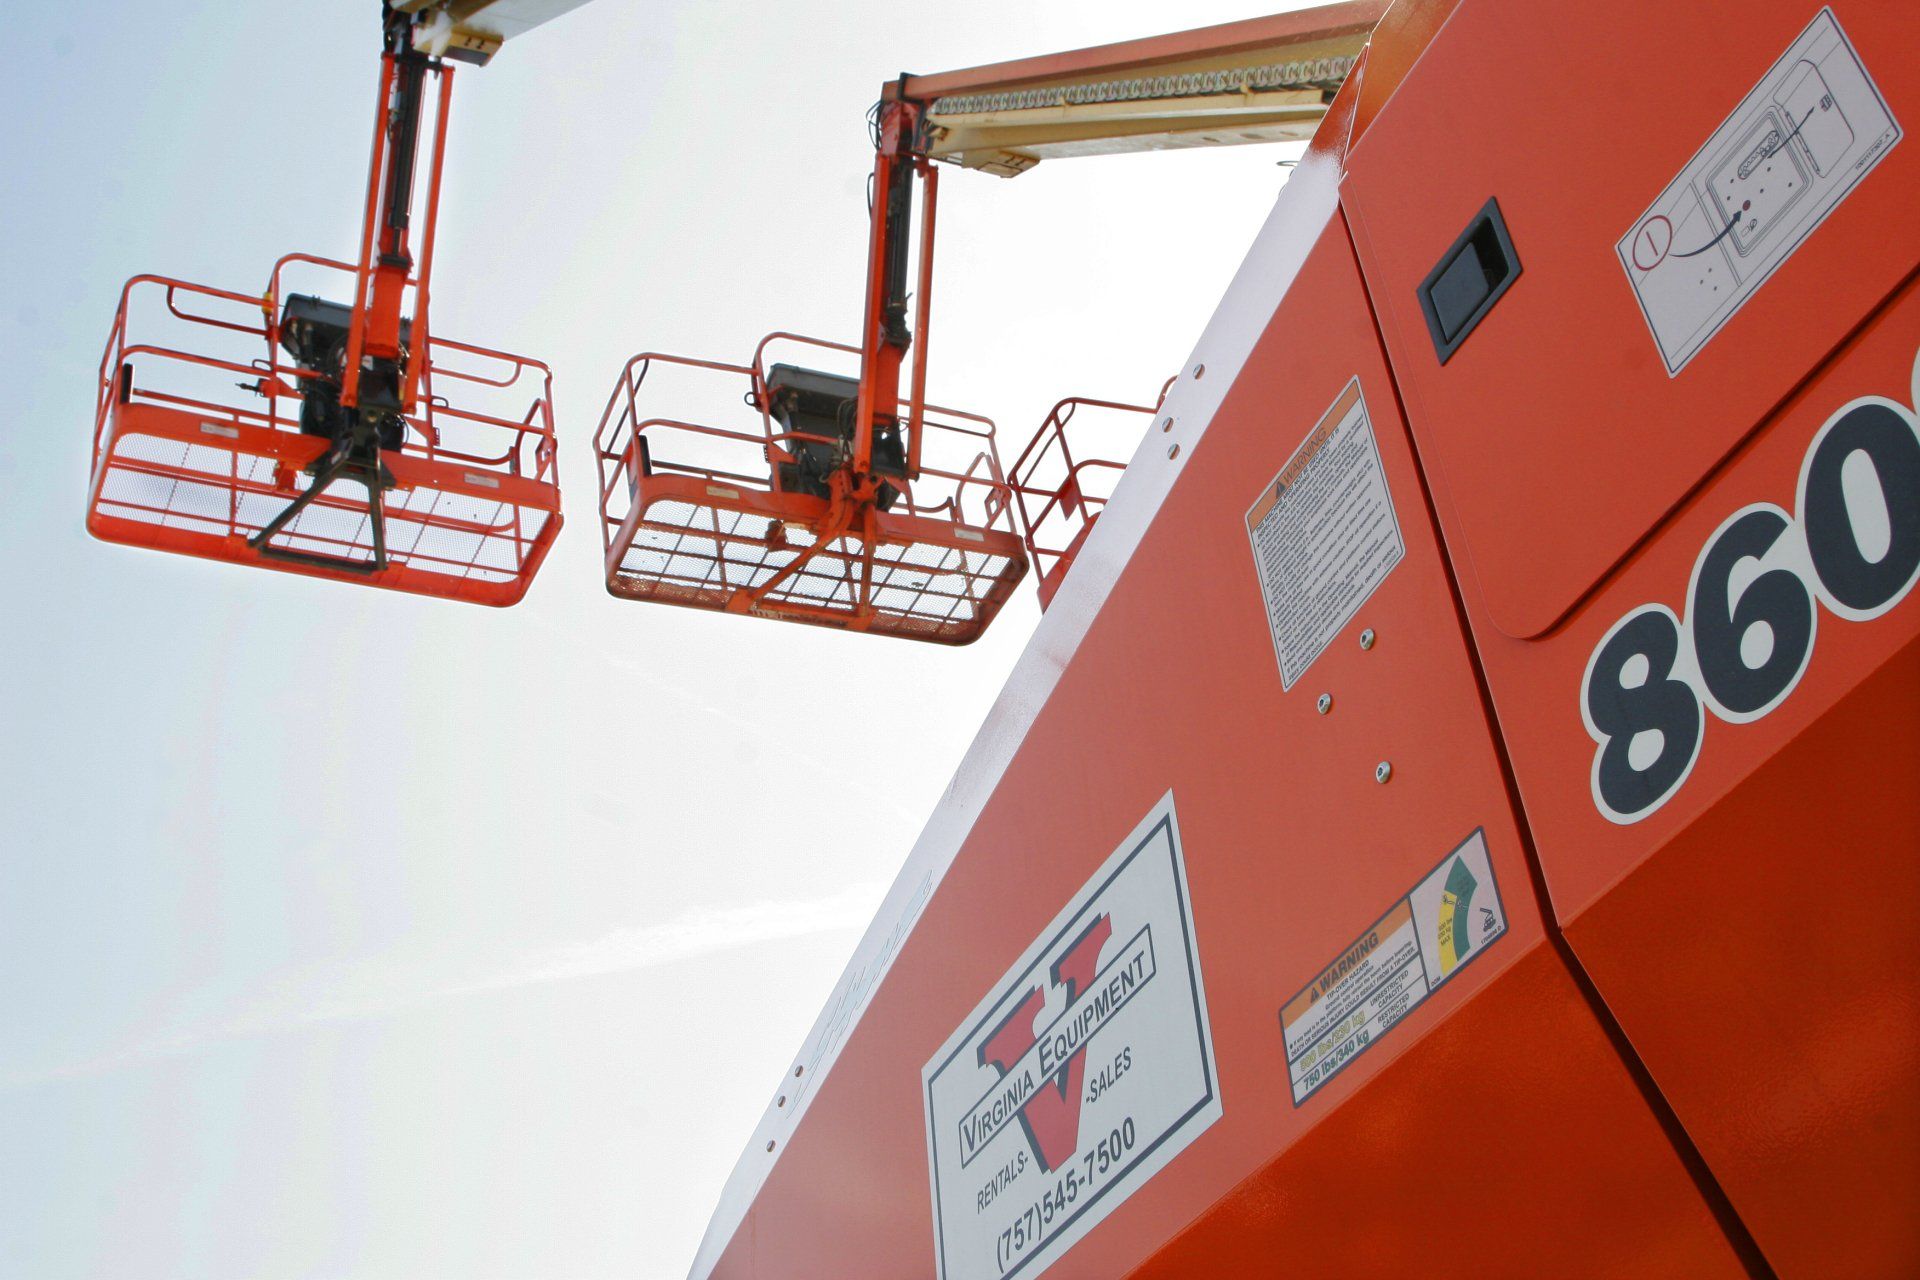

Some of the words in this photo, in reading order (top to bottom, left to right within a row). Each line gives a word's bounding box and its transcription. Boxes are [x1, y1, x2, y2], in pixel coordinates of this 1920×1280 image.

[1283, 427, 1326, 483] WARNING
[1320, 932, 1377, 993] WARNING
[1327, 978, 1348, 999] TIP-OVER
[1349, 960, 1368, 980] HAZARD
[1370, 970, 1408, 1005] UNRESTRICTED
[1377, 993, 1409, 1022] RESTRICTED
[1378, 983, 1402, 1007] CAPACITY
[1382, 1003, 1406, 1027] CAPACITY
[963, 1069, 1034, 1155] VIRGINIA
[1039, 950, 1145, 1075] EQUIPMENT
[1303, 1068, 1319, 1089] 750
[1321, 1040, 1354, 1074] lbs/340
[1356, 1030, 1369, 1045] kg
[996, 1115, 1137, 1274] (757)545-7500
